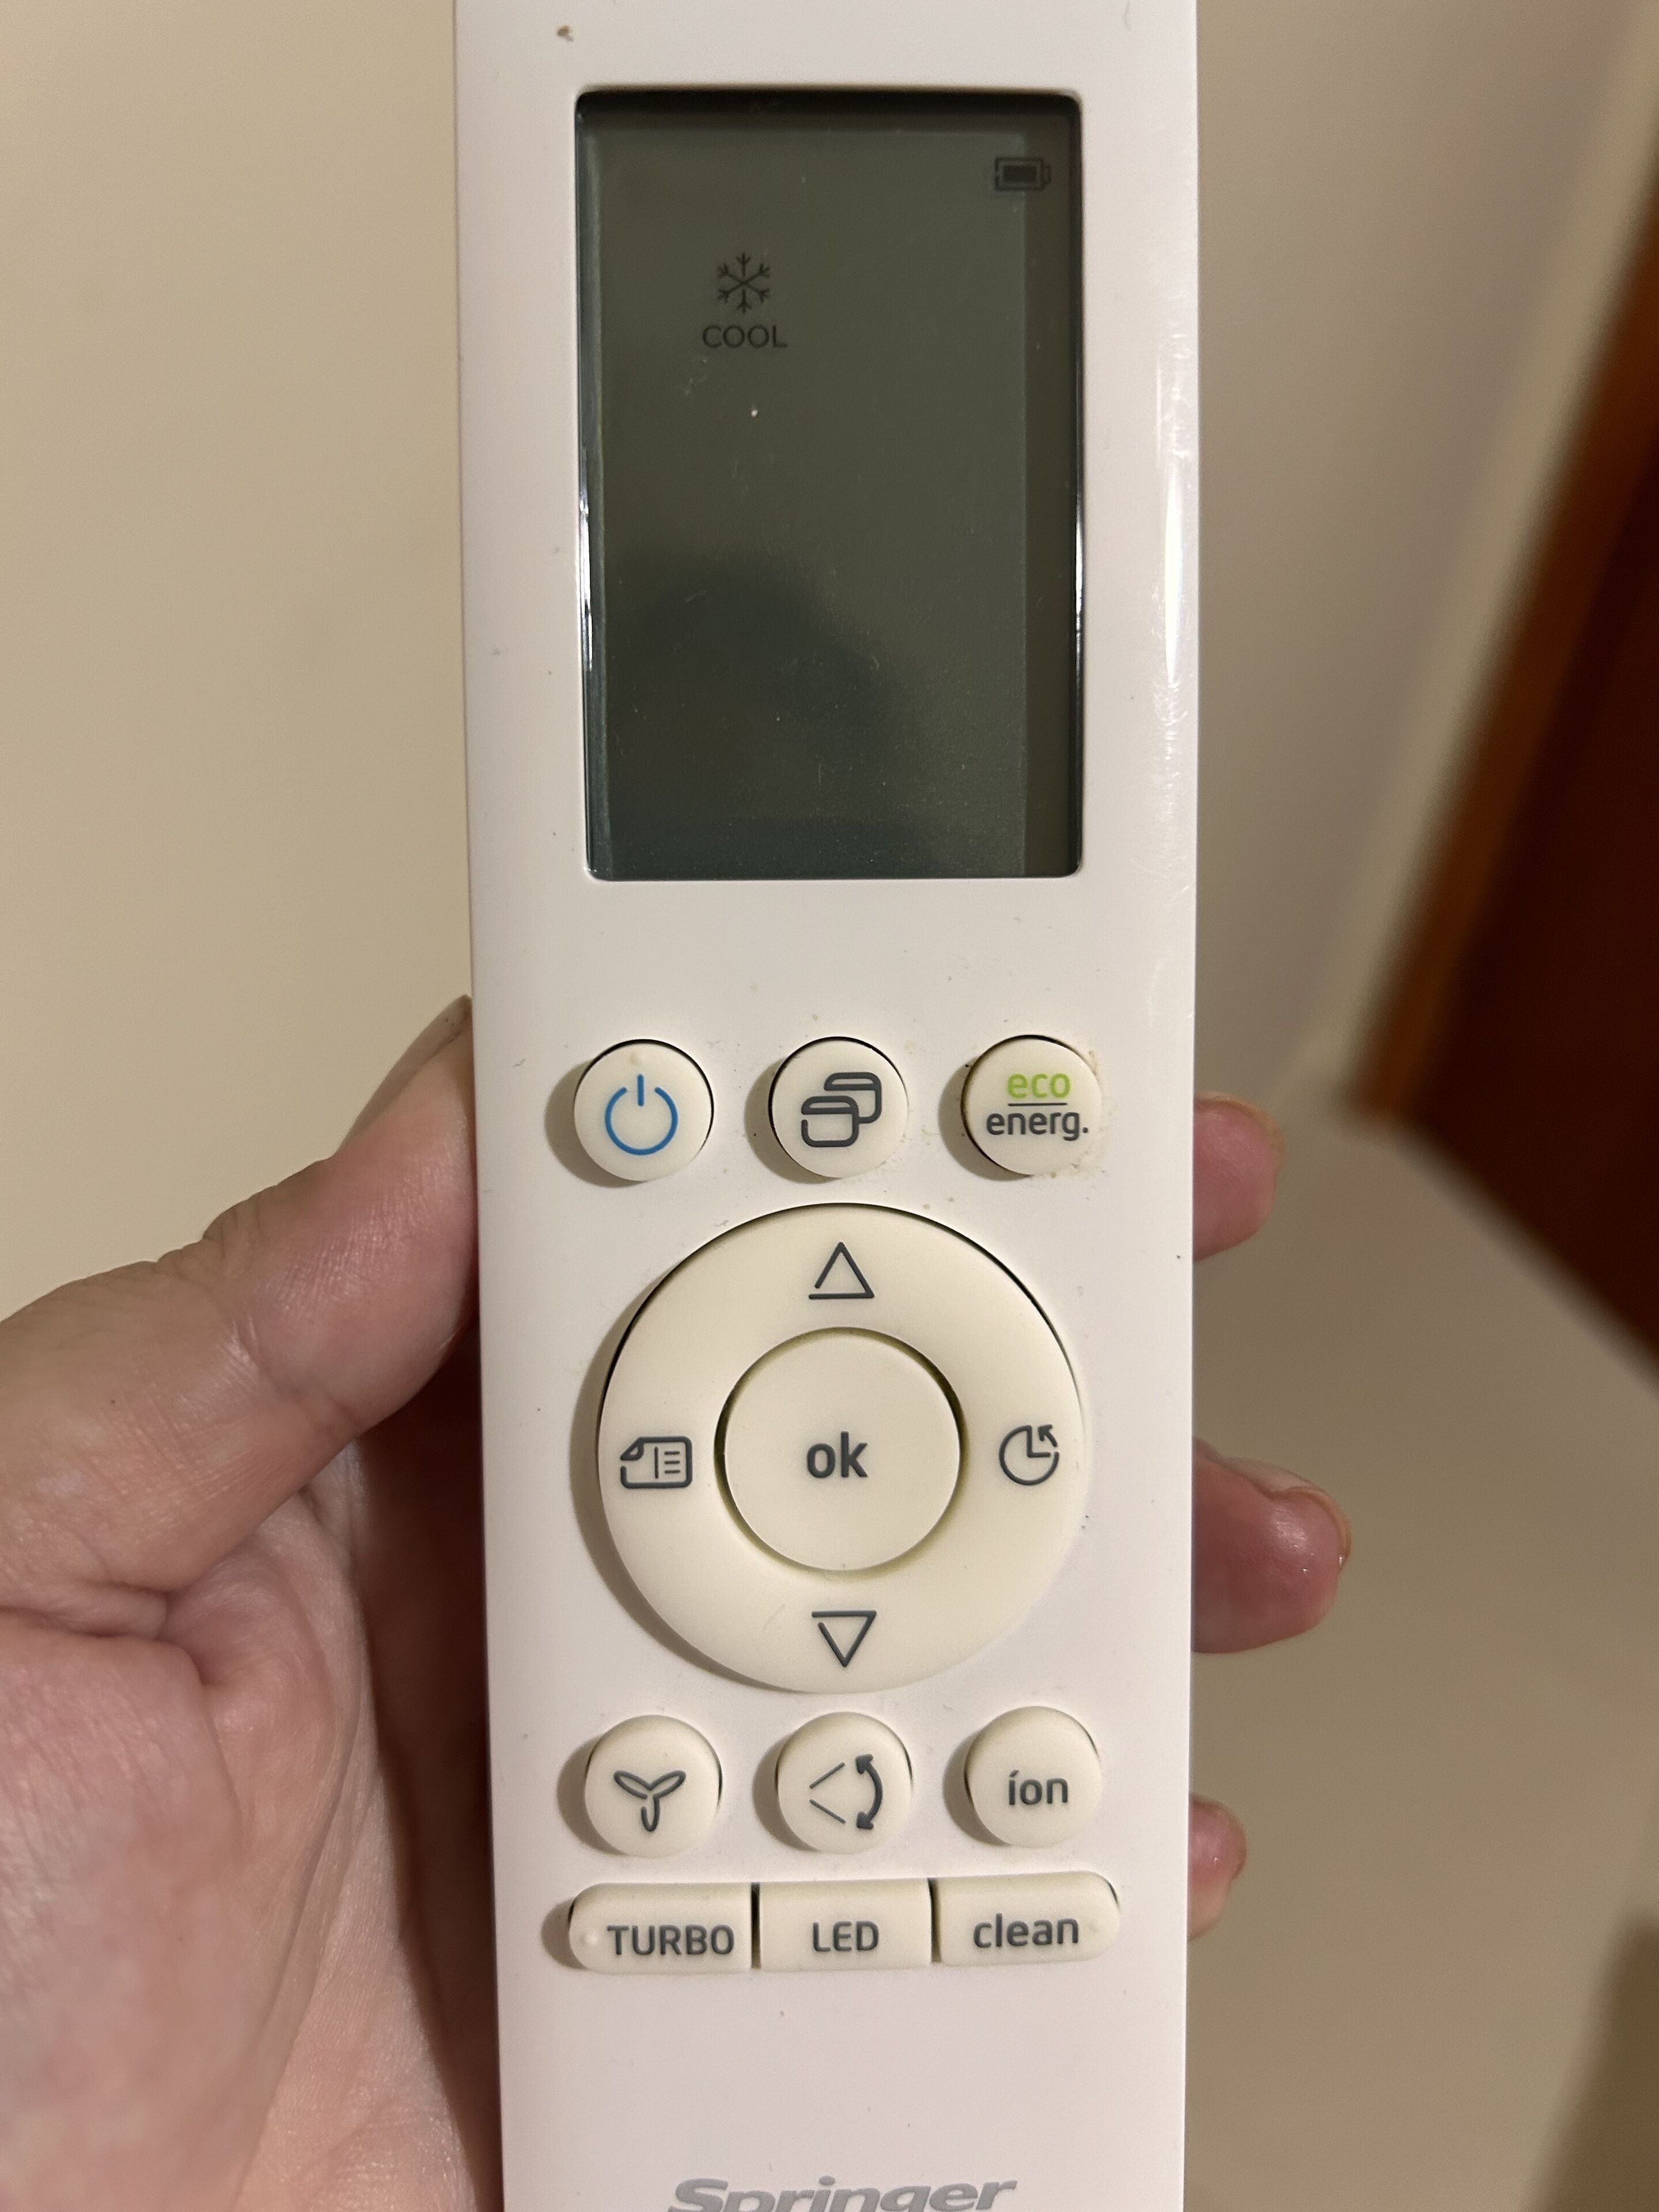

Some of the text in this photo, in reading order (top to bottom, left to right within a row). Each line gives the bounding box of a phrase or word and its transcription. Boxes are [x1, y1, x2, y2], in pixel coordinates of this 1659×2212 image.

[702, 325, 788, 348] COOL
[1007, 1073, 1071, 1099] eco
[986, 1111, 1089, 1142] energ.
[806, 1431, 868, 1479] ok
[1007, 1768, 1070, 1807] íon
[606, 1924, 735, 1956] TURBO
[812, 1920, 880, 1953] LED
[972, 1912, 1080, 1949] clean
[667, 2175, 1018, 2212] Springer
